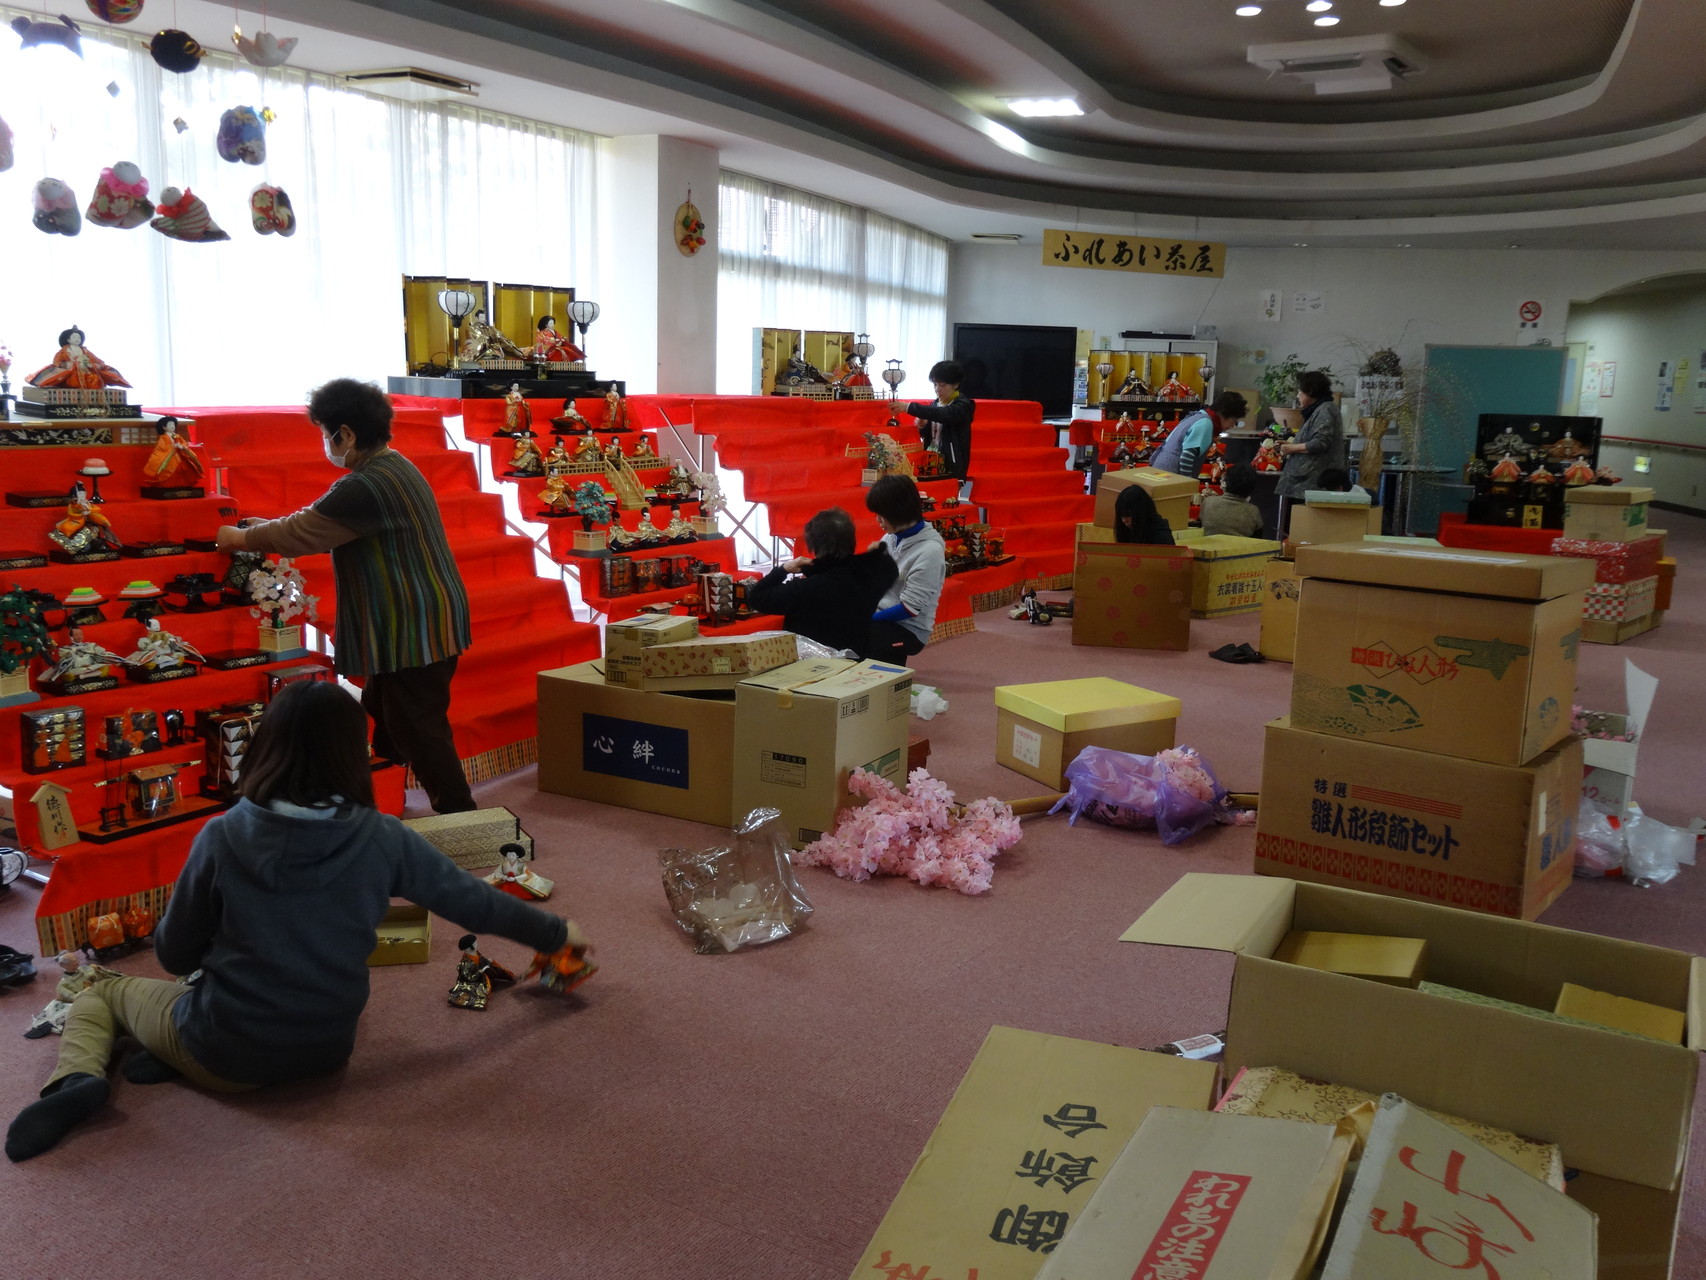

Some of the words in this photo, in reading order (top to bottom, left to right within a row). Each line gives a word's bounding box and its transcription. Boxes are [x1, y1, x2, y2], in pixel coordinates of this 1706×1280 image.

[1054, 233, 1214, 273] ふれあい茶屋
[593, 735, 655, 765] 心絆
[1311, 798, 1460, 861] 雛人形段飾セット
